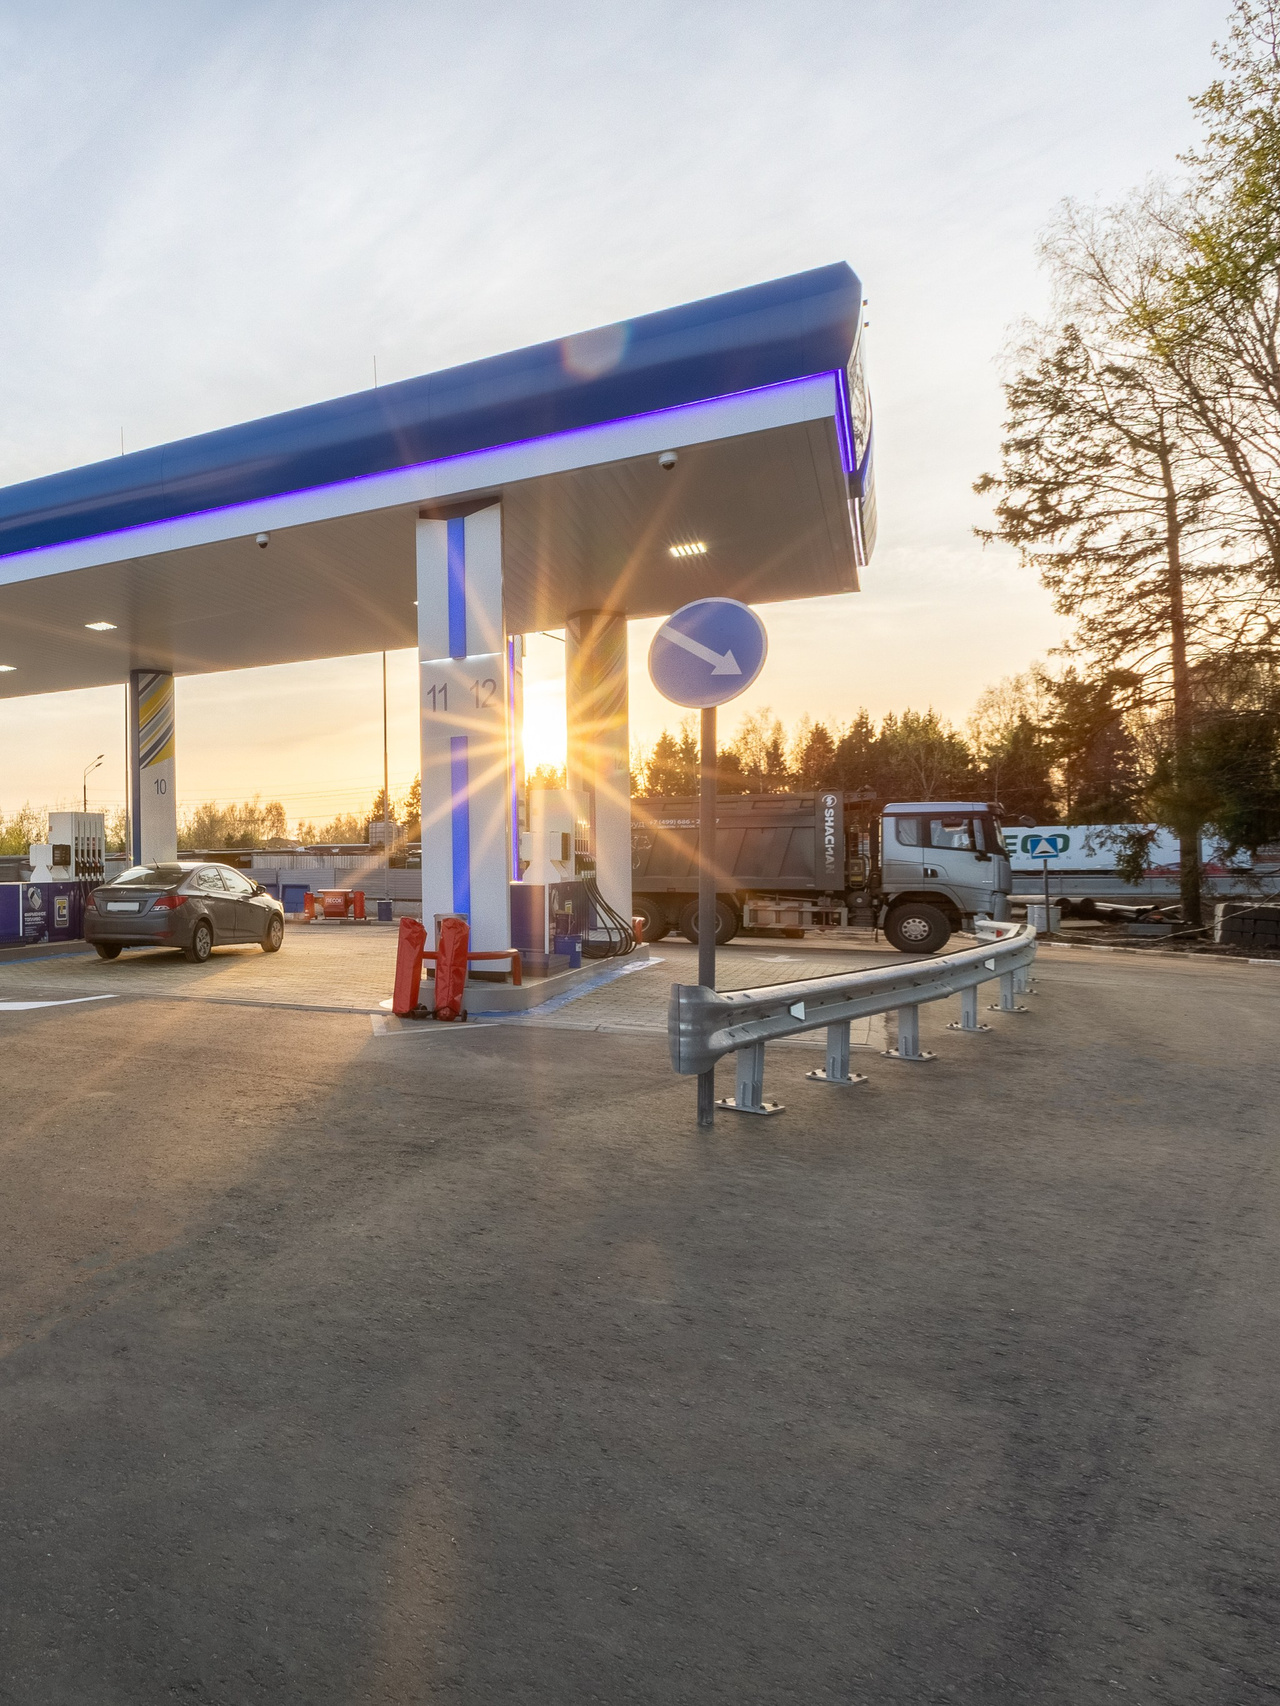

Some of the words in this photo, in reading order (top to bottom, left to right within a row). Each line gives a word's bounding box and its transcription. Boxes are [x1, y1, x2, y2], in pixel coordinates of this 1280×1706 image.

[426, 682, 448, 712] 11
[470, 678, 497, 709] 12
[154, 778, 167, 795] 10
[824, 808, 835, 874] SHACMAN
